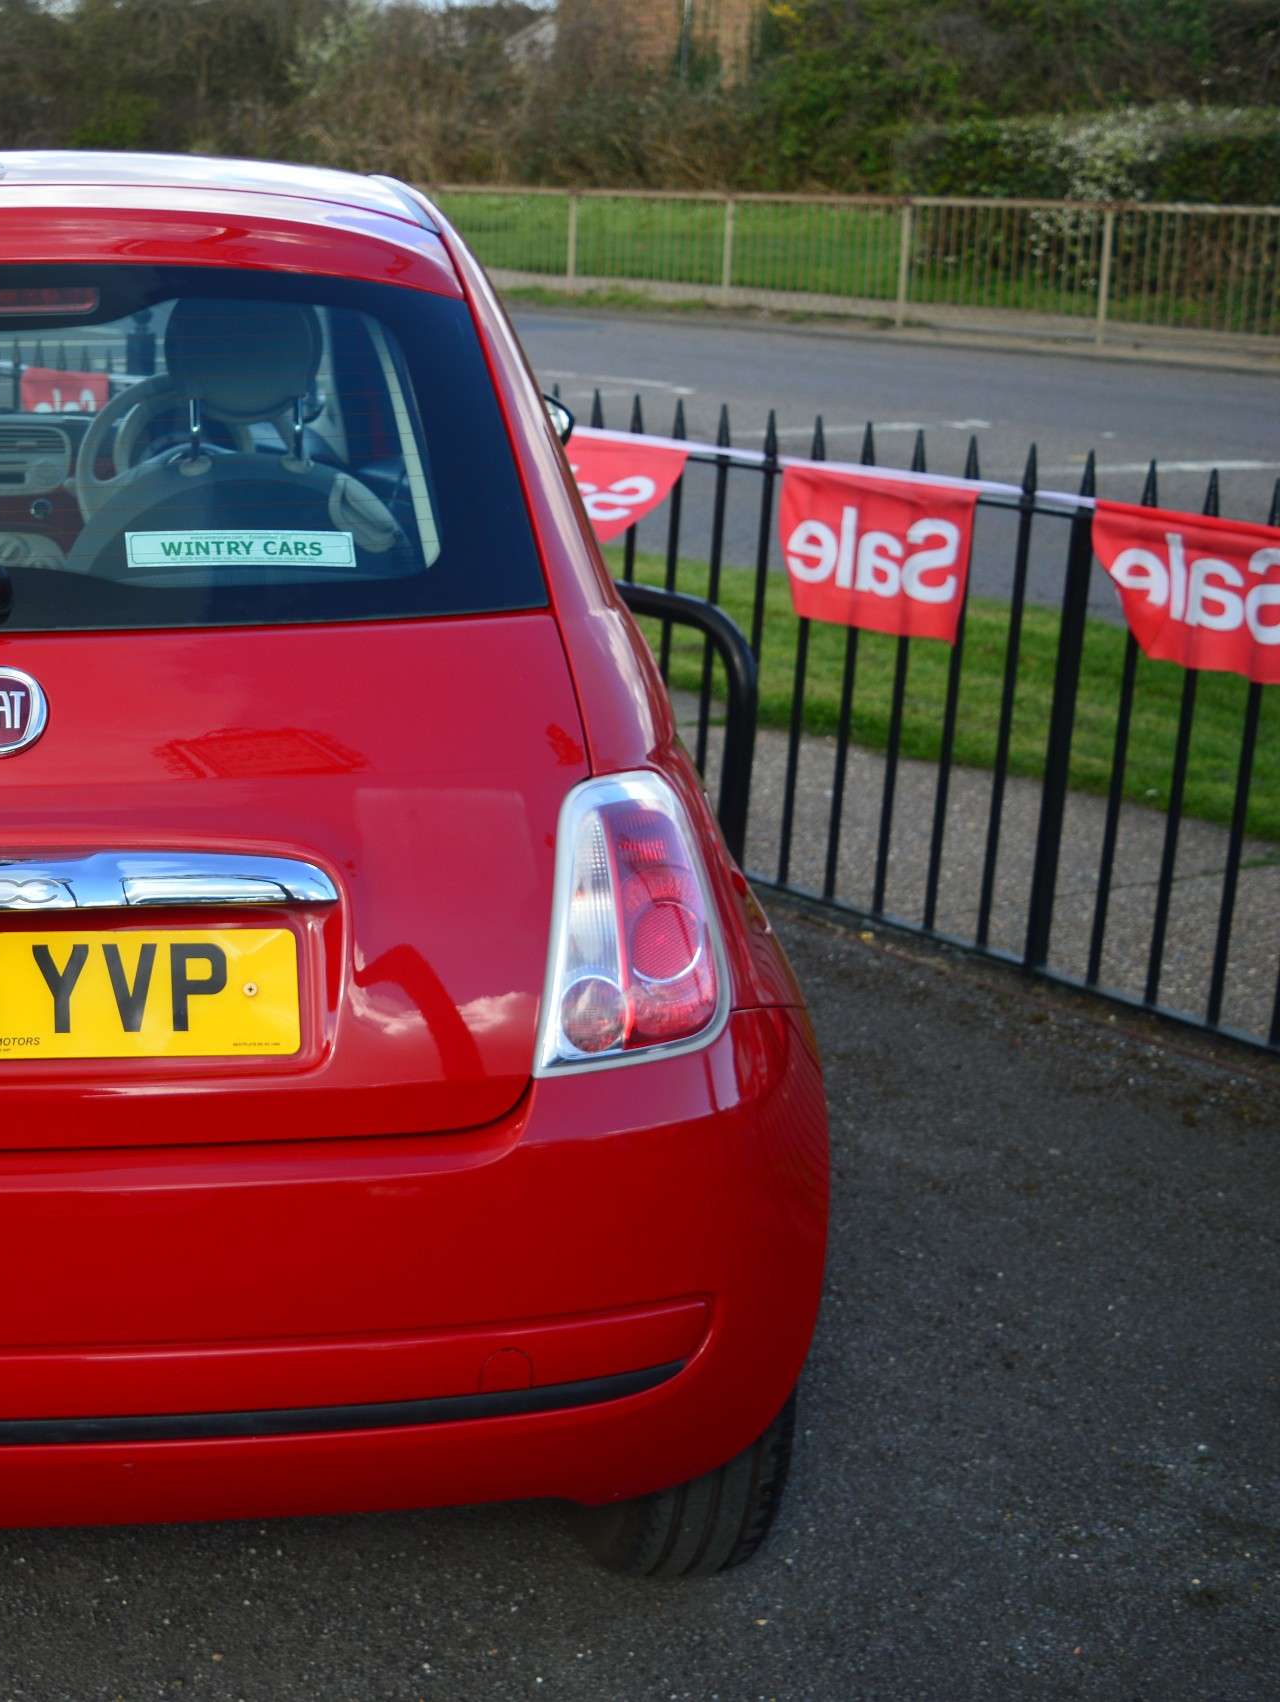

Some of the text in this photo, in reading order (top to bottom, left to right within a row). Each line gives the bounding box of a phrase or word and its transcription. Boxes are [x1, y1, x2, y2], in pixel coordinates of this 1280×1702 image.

[160, 541, 323, 556] WINTRY CARS
[31, 942, 228, 1033] YVP
